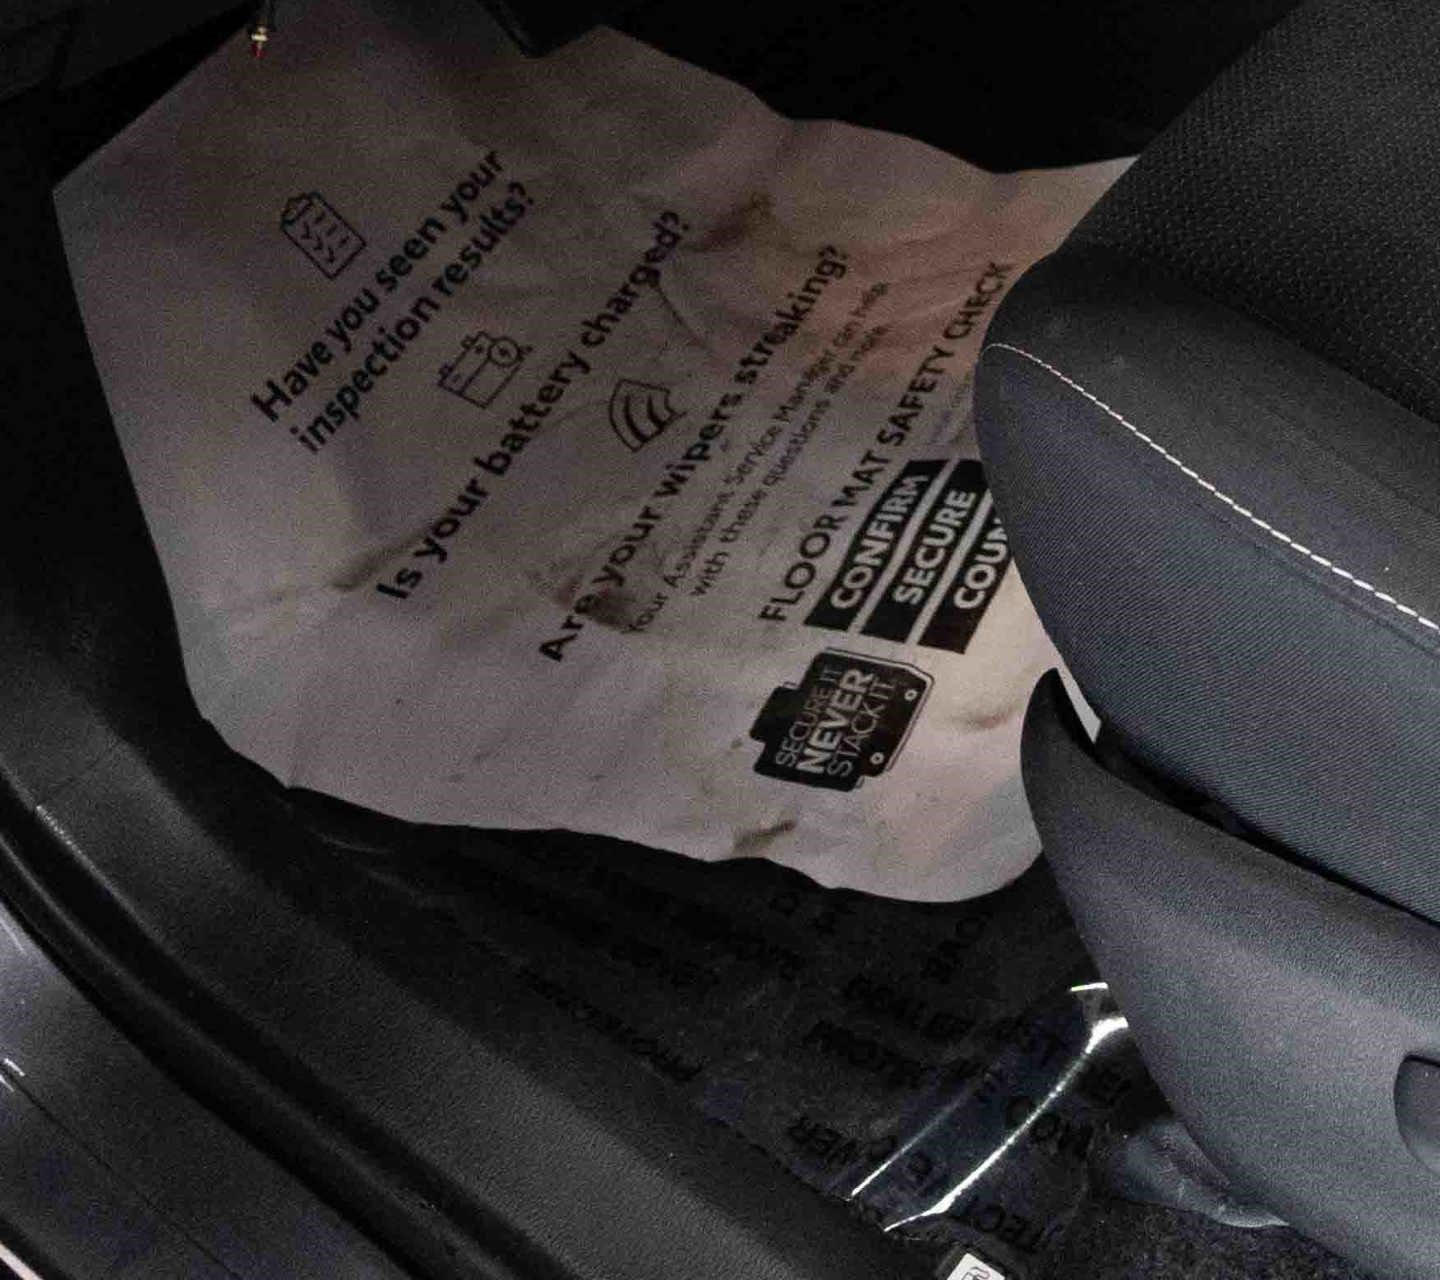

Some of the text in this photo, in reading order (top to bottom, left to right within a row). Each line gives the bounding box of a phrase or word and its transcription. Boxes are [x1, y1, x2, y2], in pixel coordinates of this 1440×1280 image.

[250, 149, 505, 423] Have you seen your
[289, 180, 536, 454] inspection results?
[375, 210, 692, 600] Is your battery charged?
[537, 244, 850, 662] Are your wipers streaking?
[758, 511, 850, 623] FLOOR
[830, 448, 891, 509] MAT
[876, 343, 956, 447] SAFETY
[943, 260, 1014, 341] CHECK
[689, 550, 730, 598] with
[829, 473, 931, 610] CONFIRM
[891, 489, 978, 606] SECURE
[952, 516, 1010, 611] COUN
[795, 668, 876, 776] NEVER
[825, 700, 886, 778] STACK
